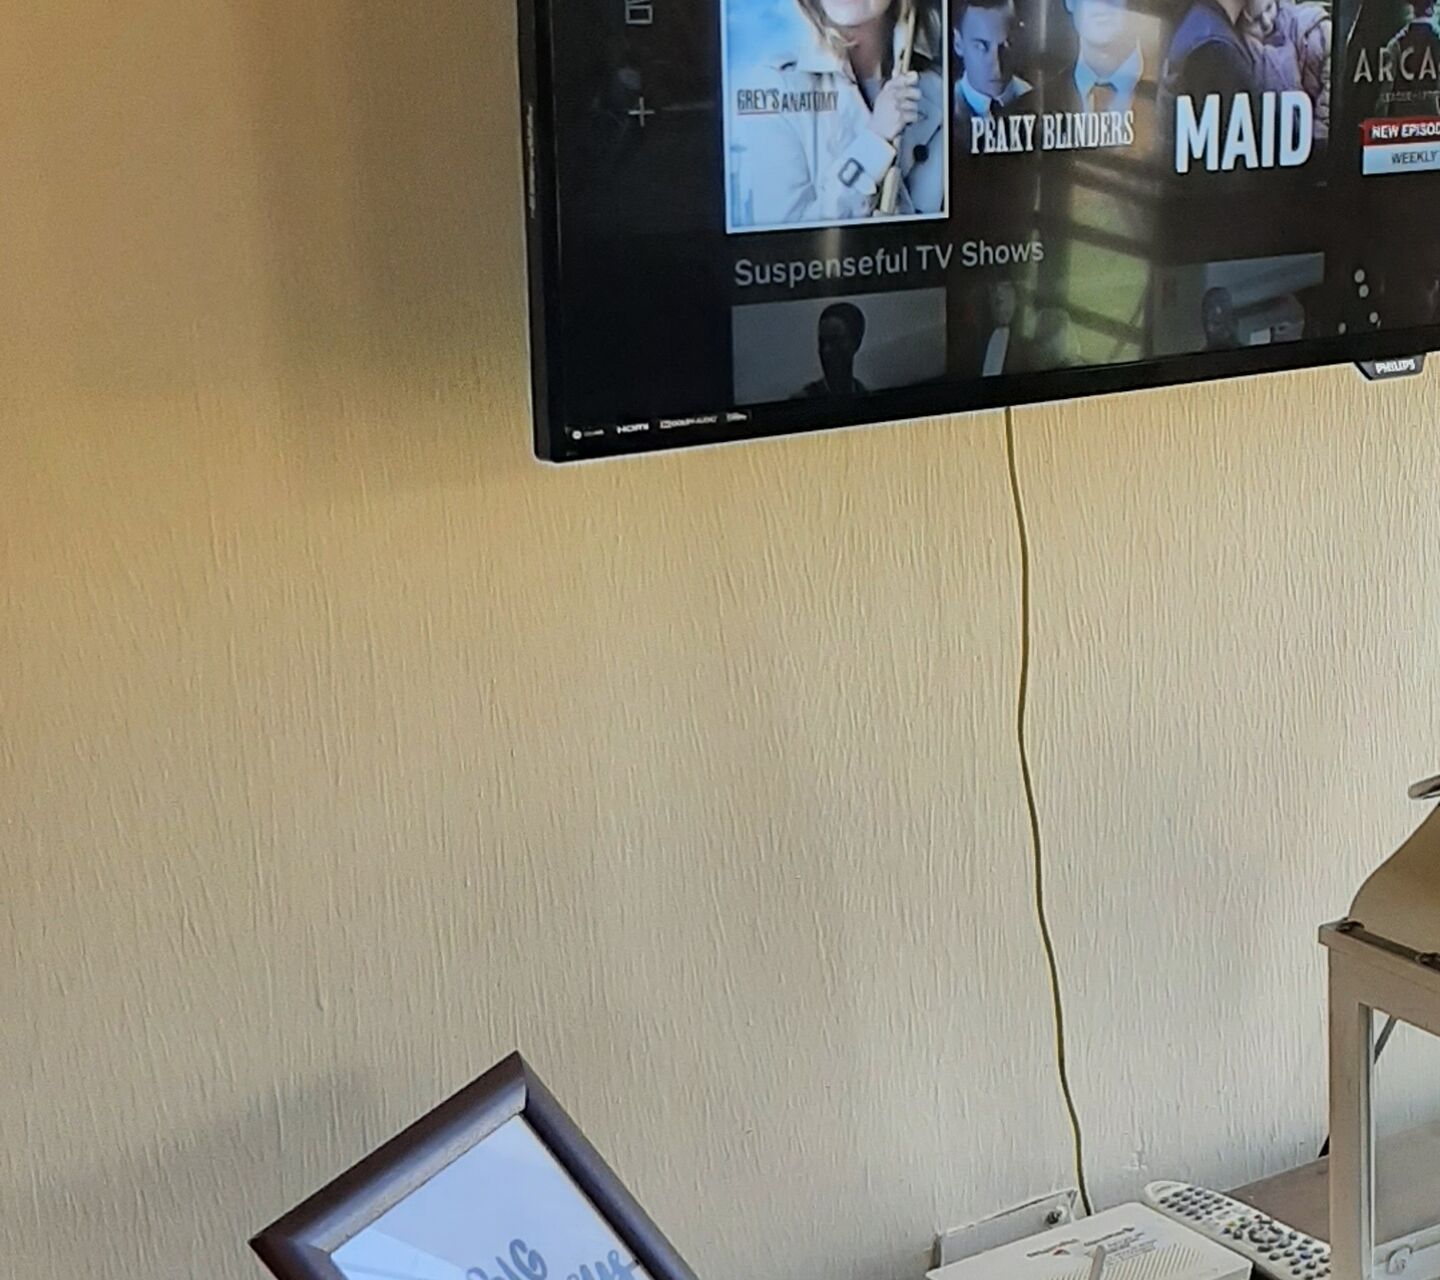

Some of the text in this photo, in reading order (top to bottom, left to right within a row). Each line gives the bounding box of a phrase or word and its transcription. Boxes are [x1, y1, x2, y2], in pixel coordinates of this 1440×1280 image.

[737, 88, 839, 113] GREY'S ANATOMY
[970, 110, 1135, 154] PEAKY BLINDERS
[1174, 89, 1314, 174] MAID
[1371, 123, 1398, 140] NEW
[1391, 149, 1440, 166] WEEKLY
[733, 237, 1045, 289] Suspenseful TV Shows
